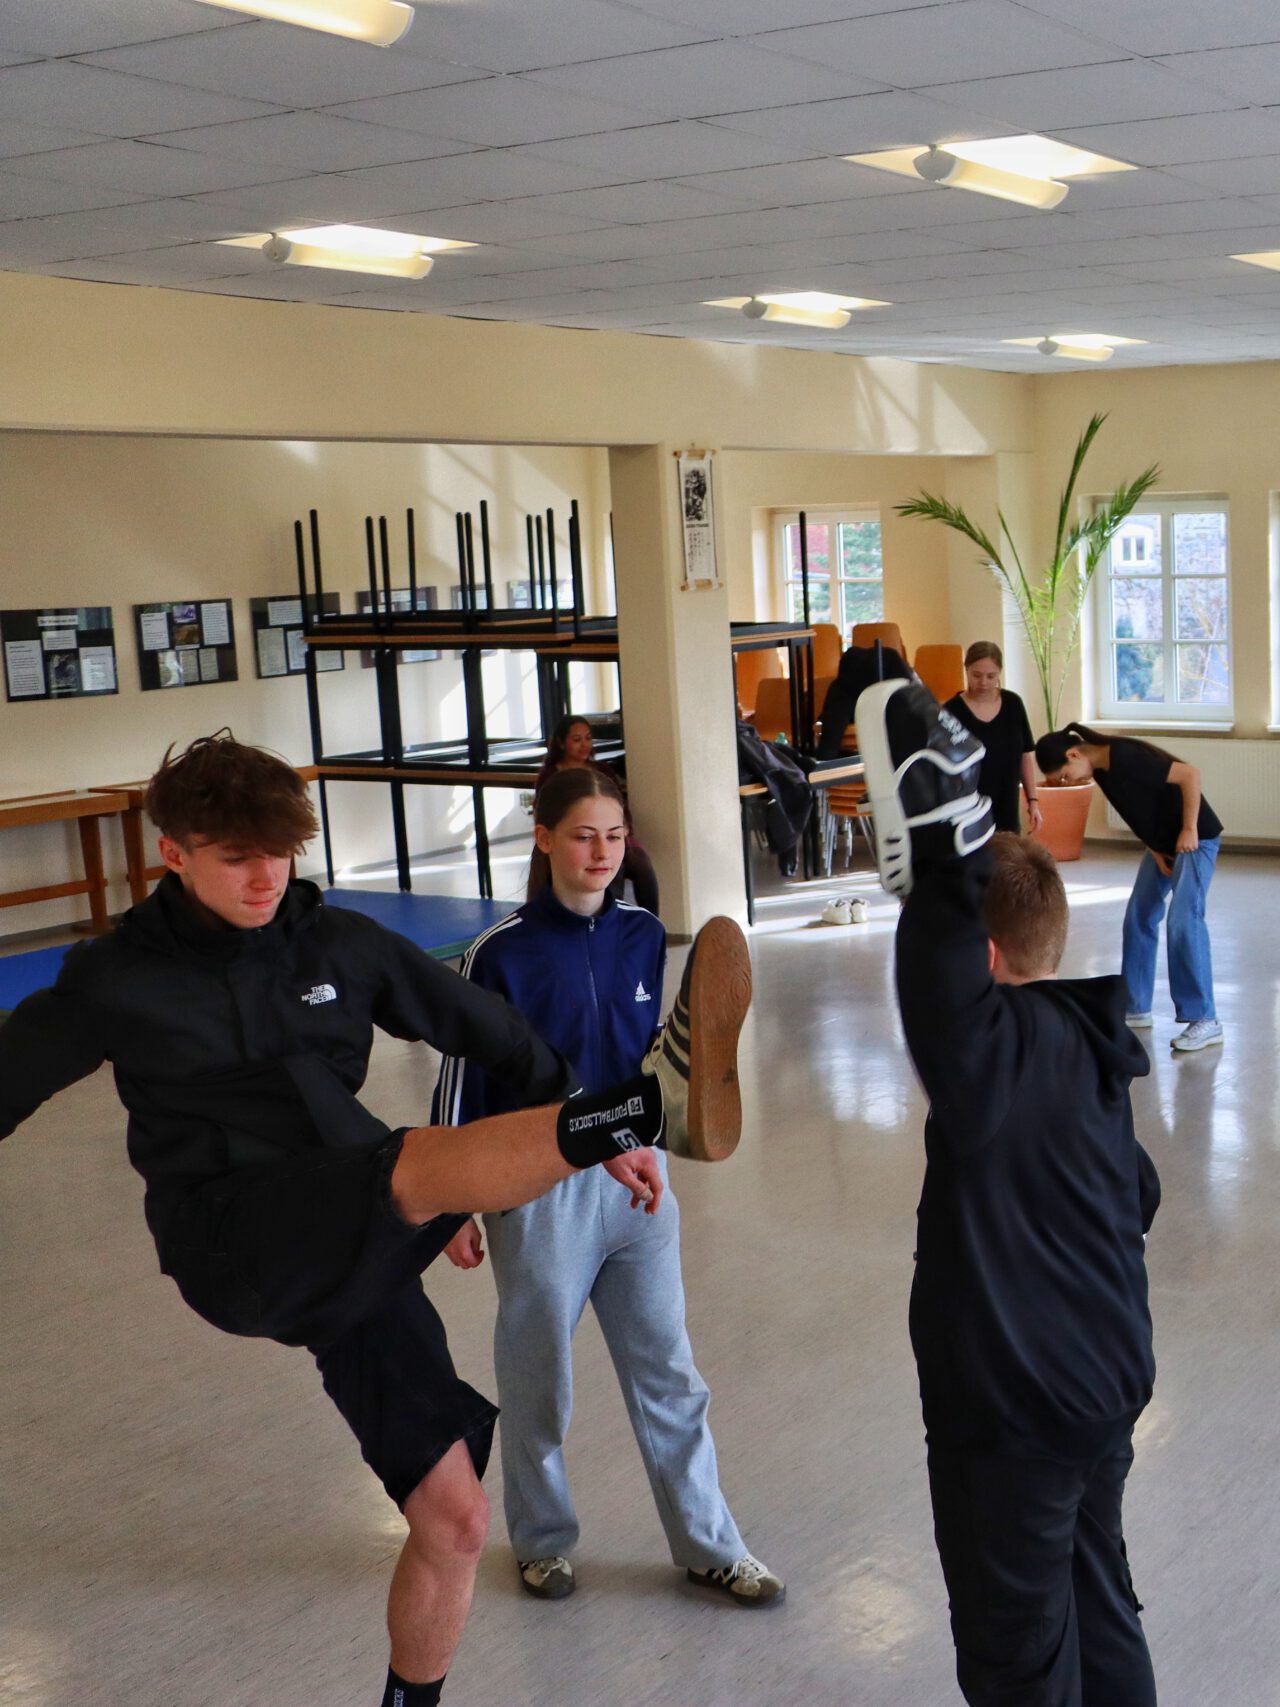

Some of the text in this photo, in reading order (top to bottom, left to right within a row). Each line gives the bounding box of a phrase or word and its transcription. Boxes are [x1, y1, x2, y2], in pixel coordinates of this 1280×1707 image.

[310, 985, 325, 993] THE
[301, 991, 325, 1001] NORTH
[309, 996, 327, 1006] FACE
[569, 1102, 629, 1132] FOOTBALLSOCKS
